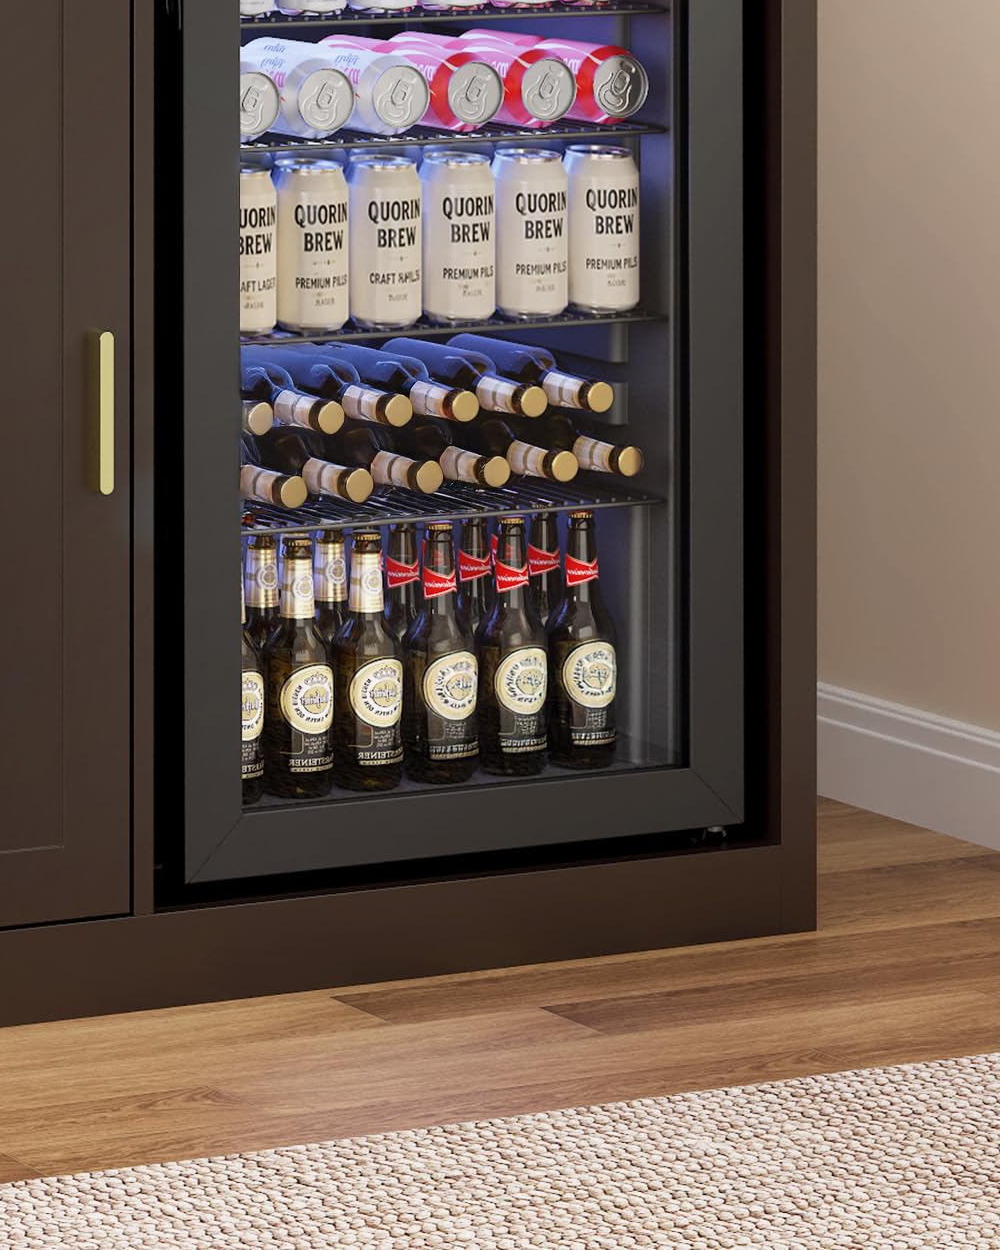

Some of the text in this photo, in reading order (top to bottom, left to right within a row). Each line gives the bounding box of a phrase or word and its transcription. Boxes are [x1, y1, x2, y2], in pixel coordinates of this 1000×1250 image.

[442, 194, 494, 220] QUORIN
[515, 190, 567, 216] QUORIN
[586, 187, 638, 211] QUORIN
[240, 205, 276, 229] UORIN
[294, 202, 348, 229] QUORIN
[368, 198, 421, 224] QUORIN
[451, 221, 490, 243] BREW
[525, 217, 563, 239] BREW
[595, 213, 634, 235] BREW
[304, 230, 344, 252] BREW
[377, 226, 416, 248] BREW
[442, 267, 479, 280] PREMIUM
[515, 260, 567, 276] PREMIUM PILS
[585, 256, 638, 270] PREMIUM PILS
[240, 281, 257, 292] AFT
[295, 277, 331, 289] PREMIUM
[369, 272, 396, 285] CRAFT
